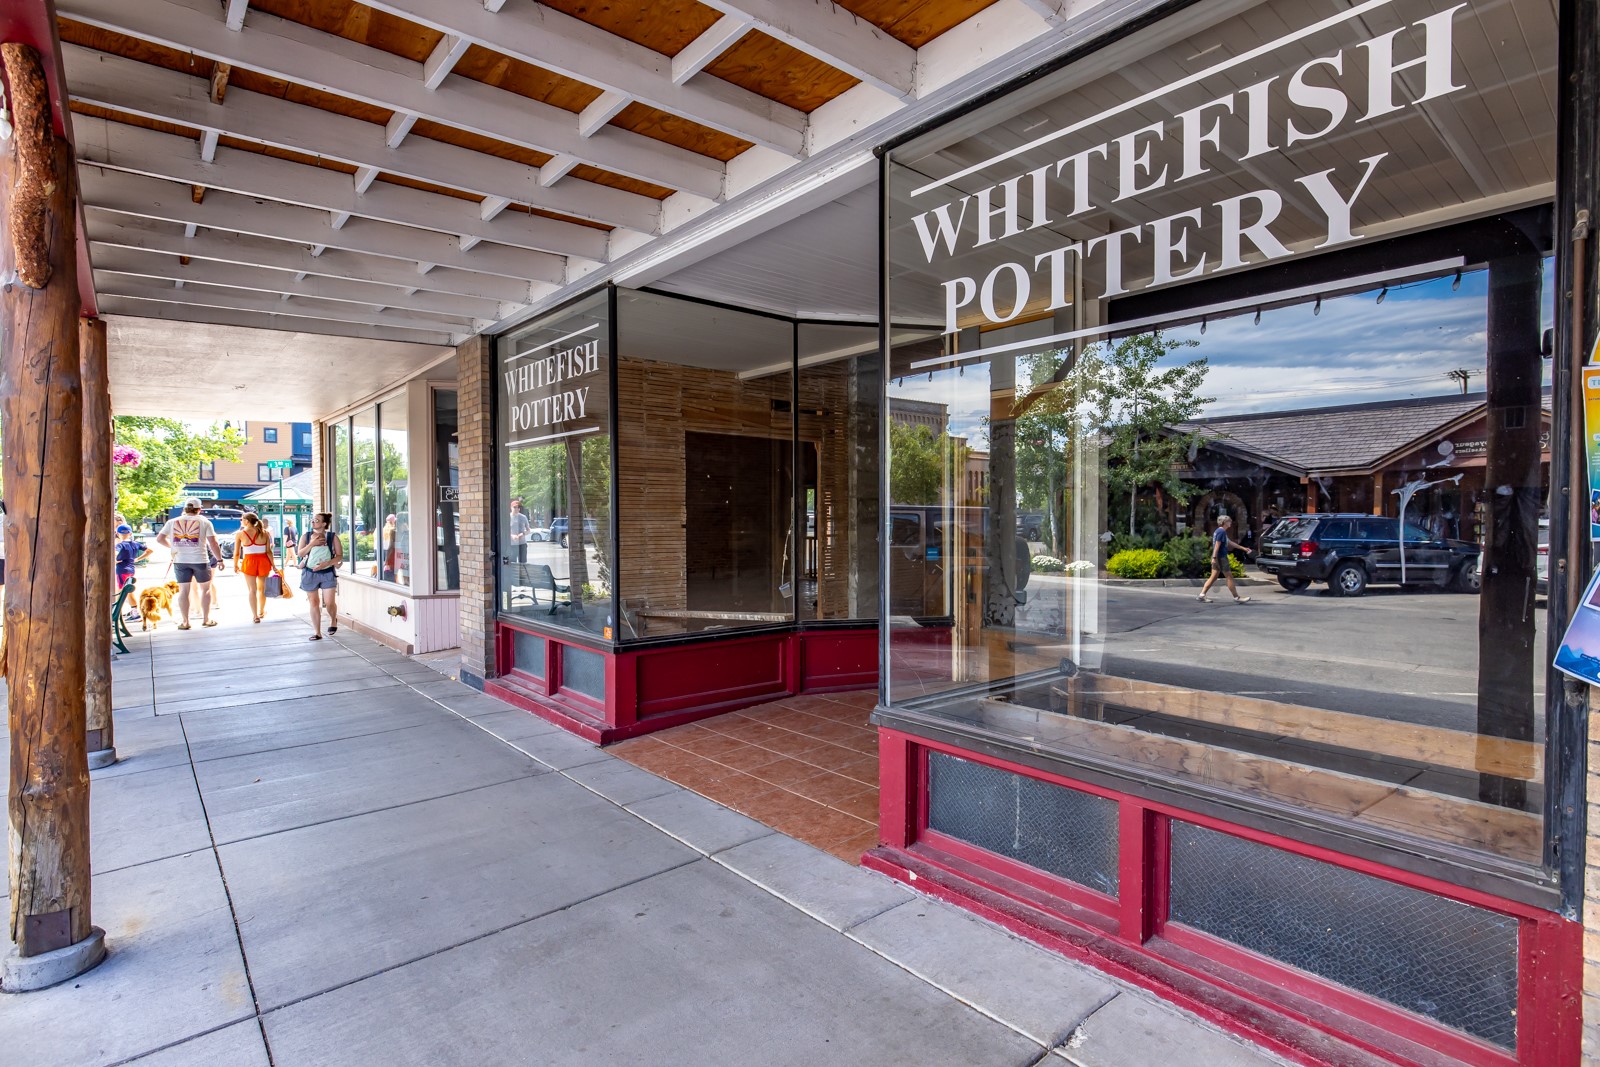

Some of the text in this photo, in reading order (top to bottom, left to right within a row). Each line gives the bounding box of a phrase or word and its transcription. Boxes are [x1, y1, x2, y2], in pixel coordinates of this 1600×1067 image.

[911, 2, 1467, 264] WHITEFISH
[940, 152, 1389, 336] POTTERY
[504, 339, 600, 396] WHITEFISH
[511, 386, 589, 433] POTTERY
